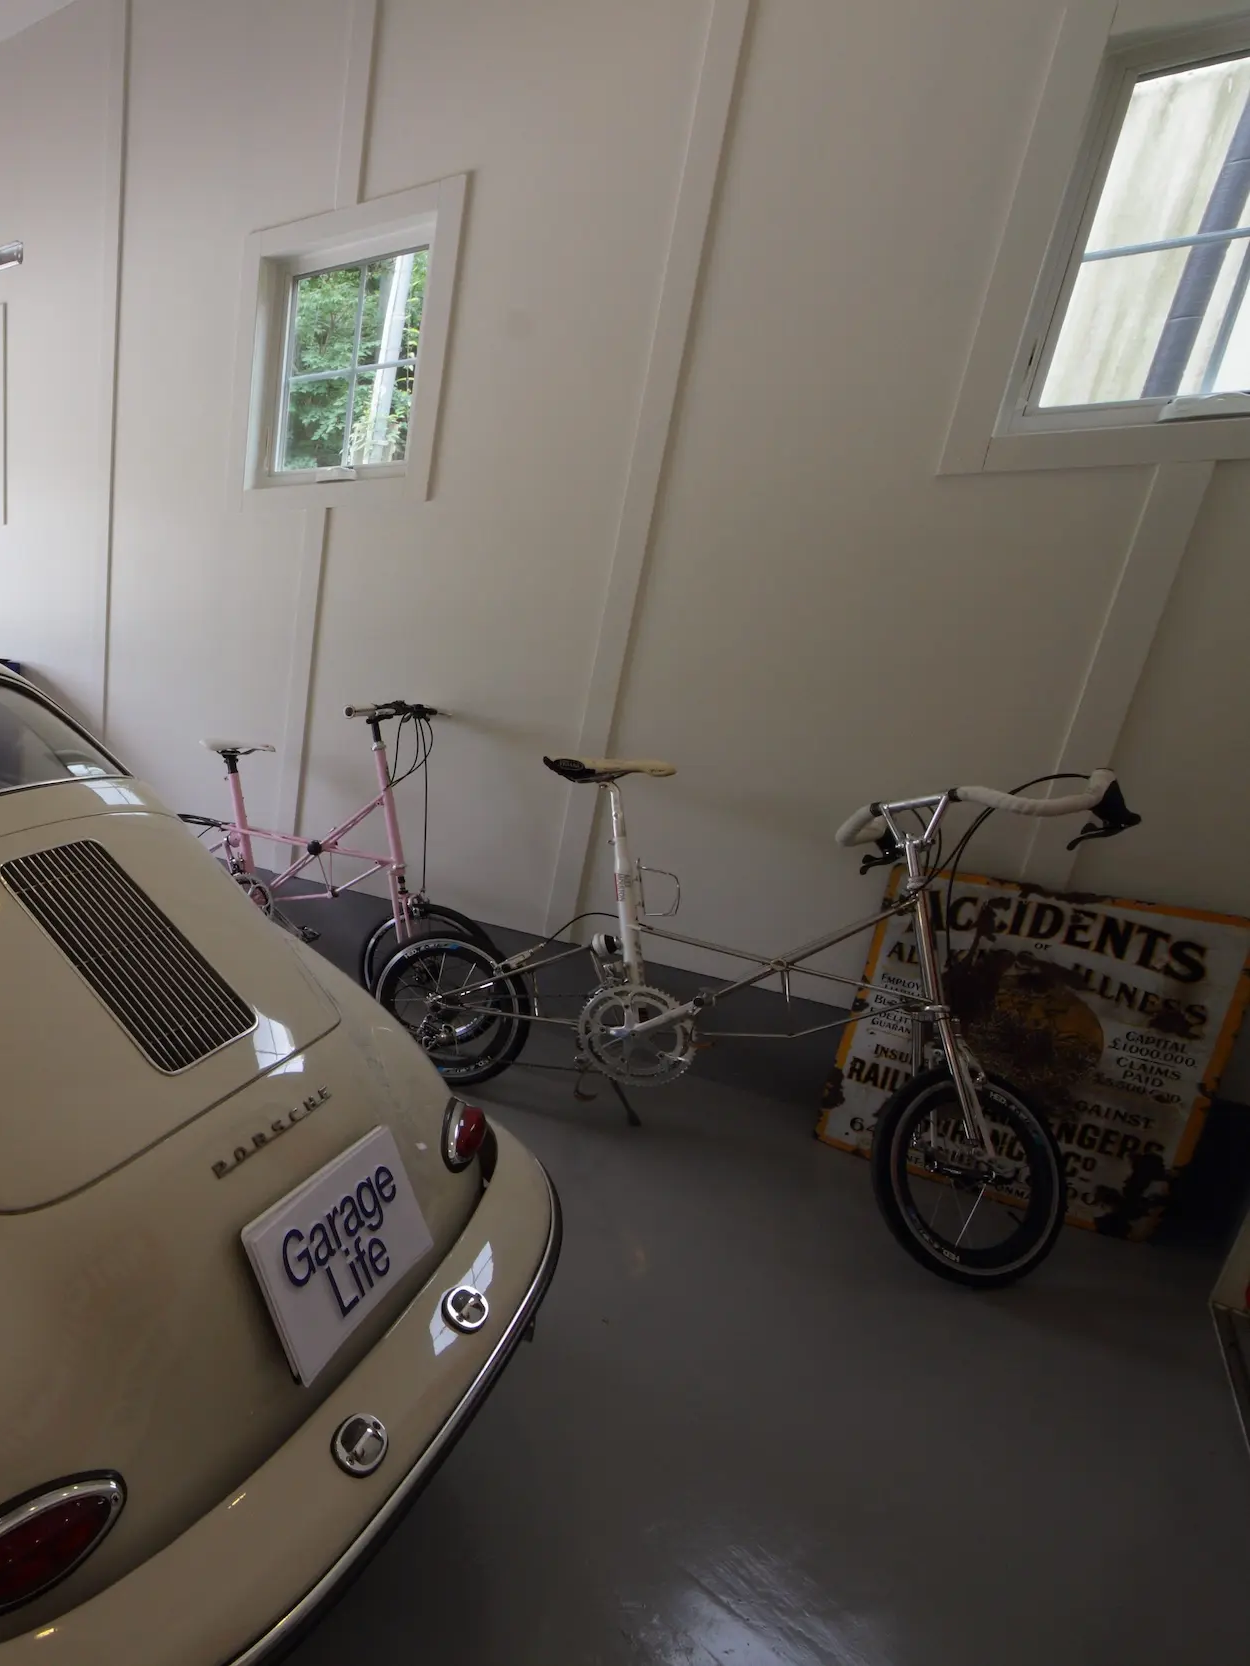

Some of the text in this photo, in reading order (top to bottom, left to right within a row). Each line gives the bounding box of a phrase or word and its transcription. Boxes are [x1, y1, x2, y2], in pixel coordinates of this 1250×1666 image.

[887, 941, 919, 964] AL
[1034, 942, 1052, 951] OF
[881, 973, 920, 990] EMPLOY
[1073, 963, 1207, 1027] LLNESS
[871, 1017, 911, 1034] GUARAN
[1125, 1031, 1187, 1054] CAPITAL
[848, 1056, 911, 1092] RAIL
[1117, 1056, 1181, 1080] CLAIMS
[1123, 1070, 1163, 1087] PAID
[1075, 1100, 1156, 1129] GAINST
[211, 1085, 333, 1179] PORSCHE
[282, 1166, 396, 1288] Garage
[325, 1236, 390, 1318] Life
